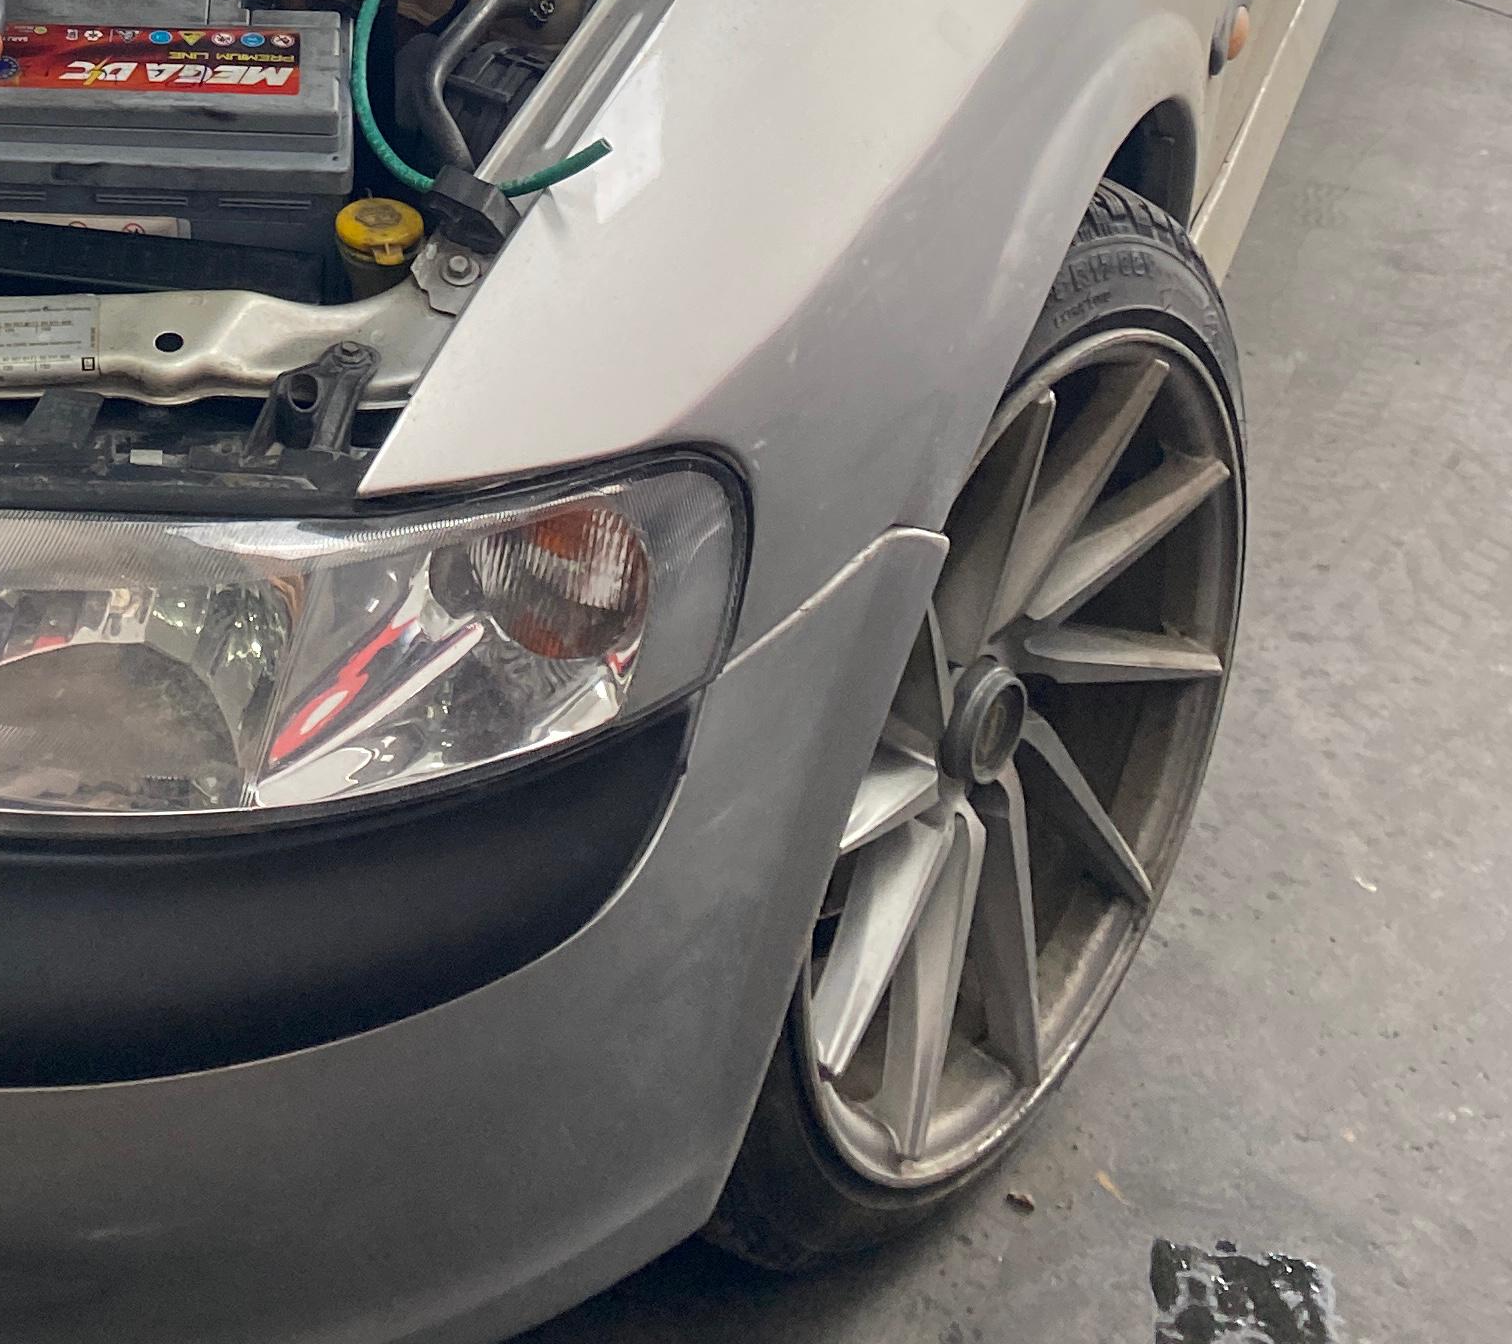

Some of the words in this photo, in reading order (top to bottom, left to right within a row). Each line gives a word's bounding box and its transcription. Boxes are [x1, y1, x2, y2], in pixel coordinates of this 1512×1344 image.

[168, 50, 210, 61] LINE
[216, 51, 296, 63] PREMIUM
[146, 62, 296, 87] MEGA
